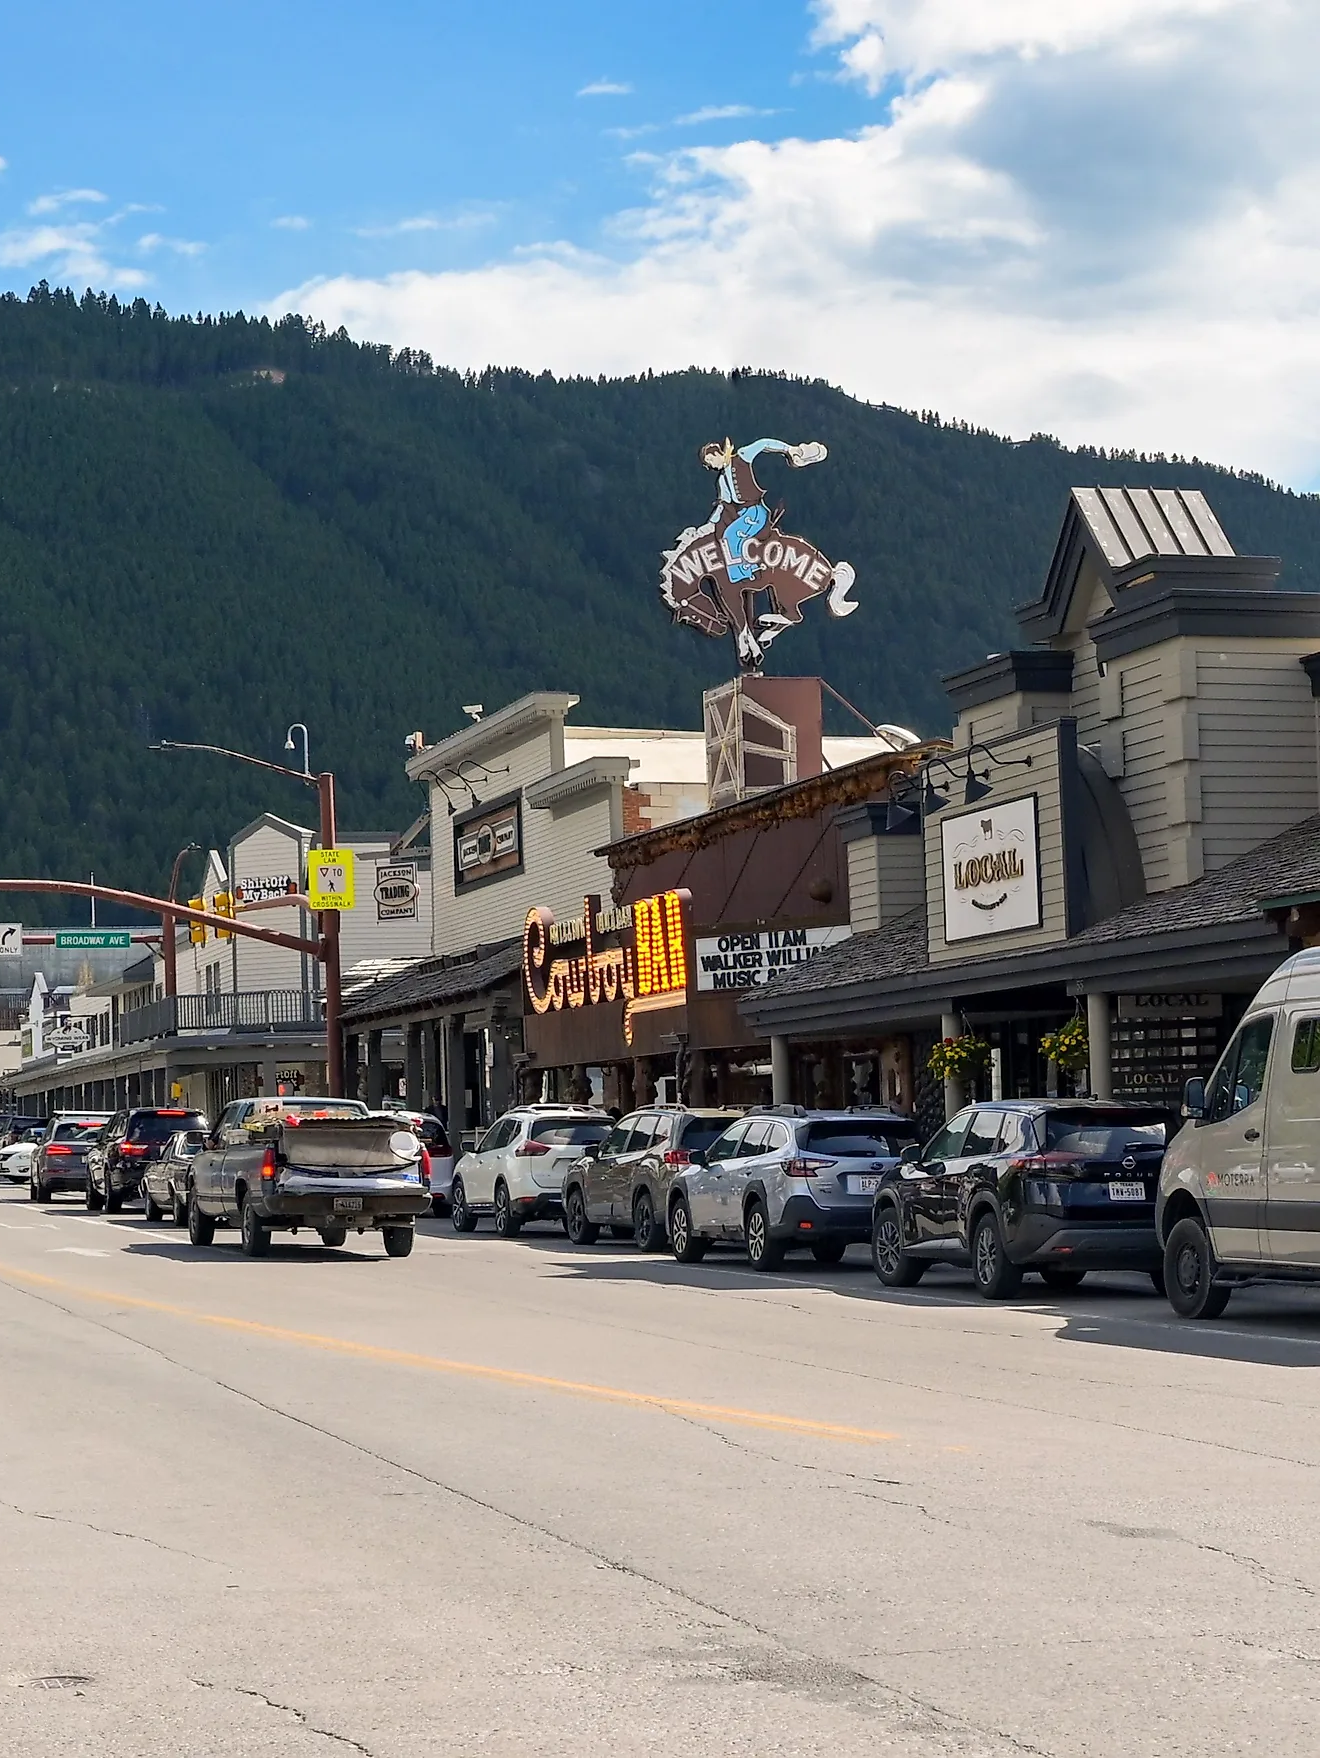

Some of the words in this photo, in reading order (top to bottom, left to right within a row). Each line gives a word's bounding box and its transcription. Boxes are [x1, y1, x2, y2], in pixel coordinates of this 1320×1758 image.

[670, 537, 830, 591] WELCOME
[332, 868, 343, 877] TO
[380, 868, 412, 879] JACKSON
[953, 848, 1024, 890] LOCAL
[380, 885, 410, 900] TRADING
[380, 907, 413, 916] COMPANY
[60, 936, 105, 946] BROADWAY
[109, 936, 125, 945] AVE
[634, 890, 687, 996] BAR
[717, 932, 760, 953] OPEN
[700, 951, 762, 972] WALKER
[766, 945, 826, 967] WILLIA
[713, 969, 761, 989] MUSIC
[1135, 993, 1209, 1007] LOCAL
[1124, 1073, 1178, 1085] LOCAL
[1217, 1173, 1255, 1187] MOTERRA
